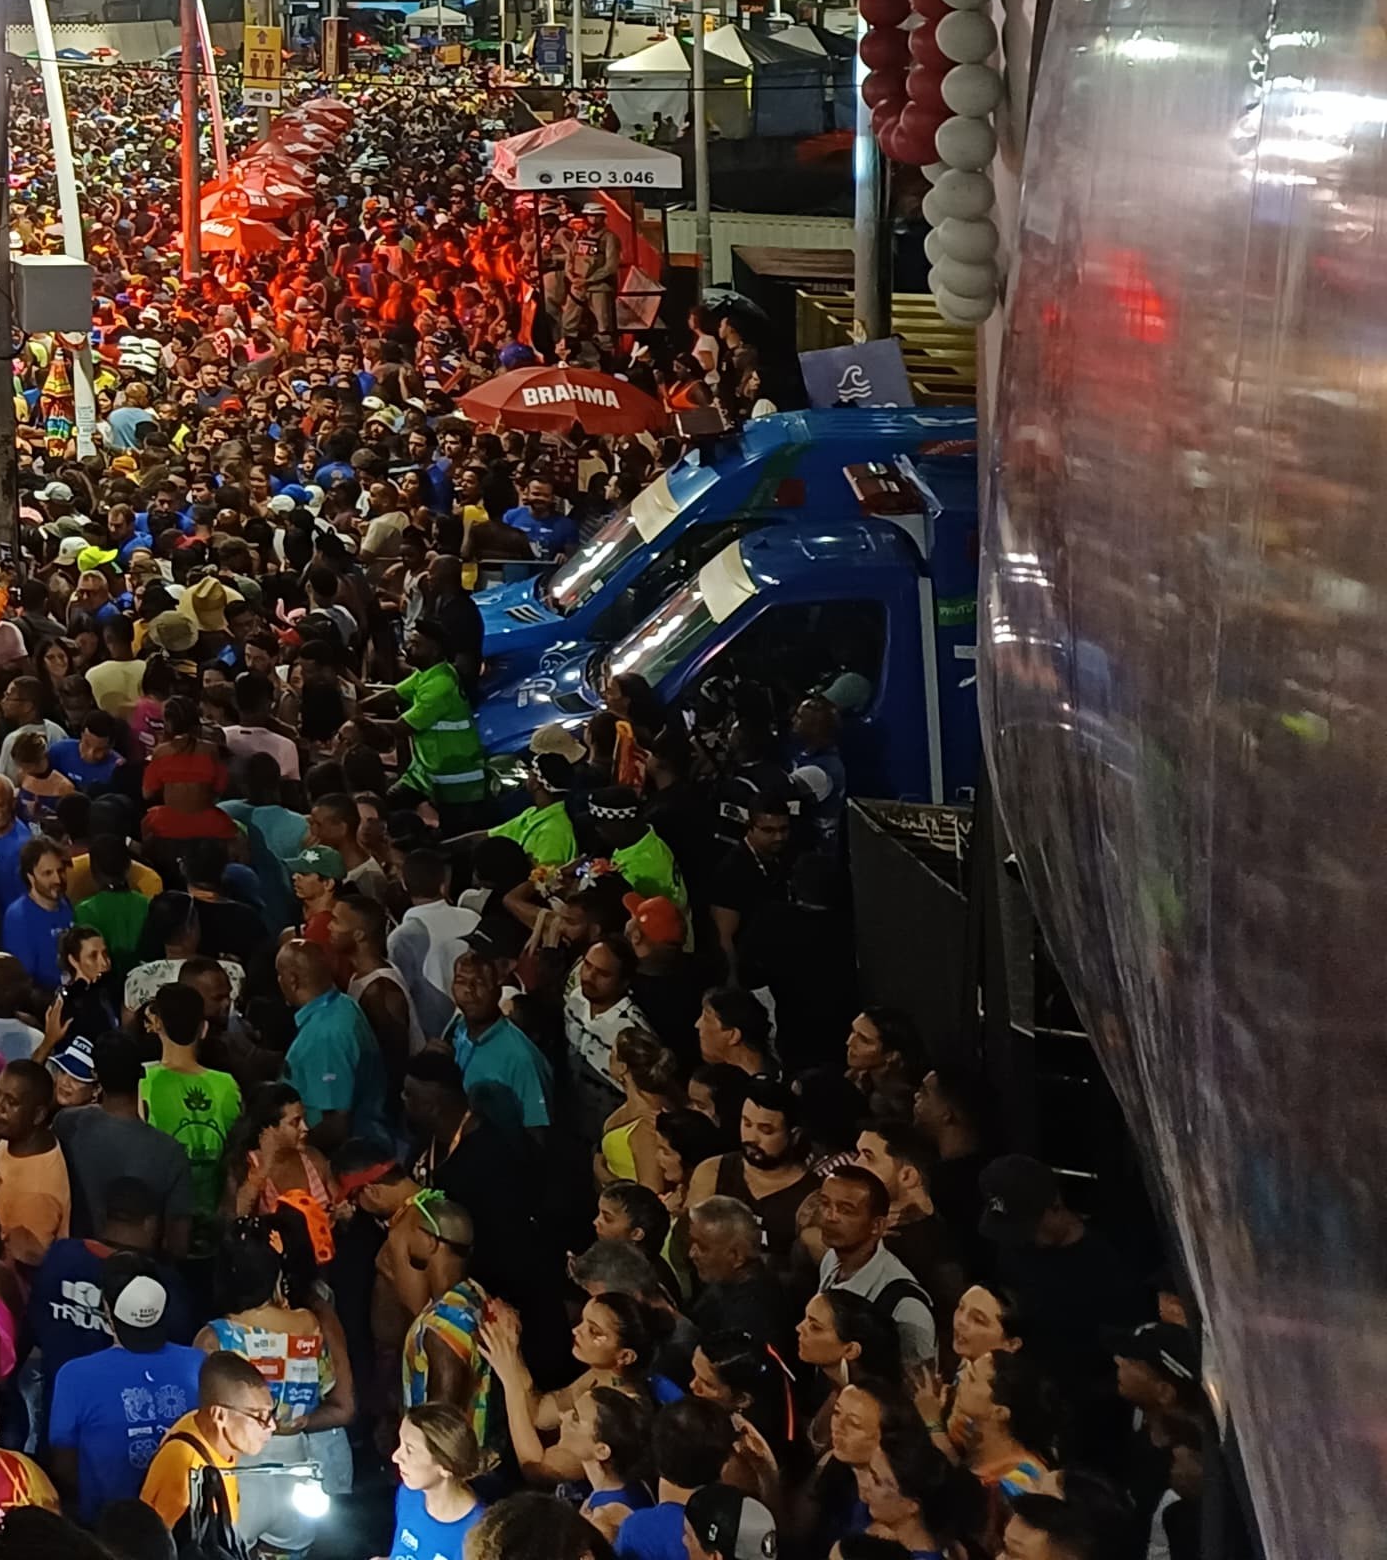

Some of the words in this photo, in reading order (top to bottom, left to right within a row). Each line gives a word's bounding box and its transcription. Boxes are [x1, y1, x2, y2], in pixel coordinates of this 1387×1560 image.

[563, 170, 602, 184] PEO
[608, 171, 655, 184] 3.046
[522, 384, 621, 409] BRAHMA
